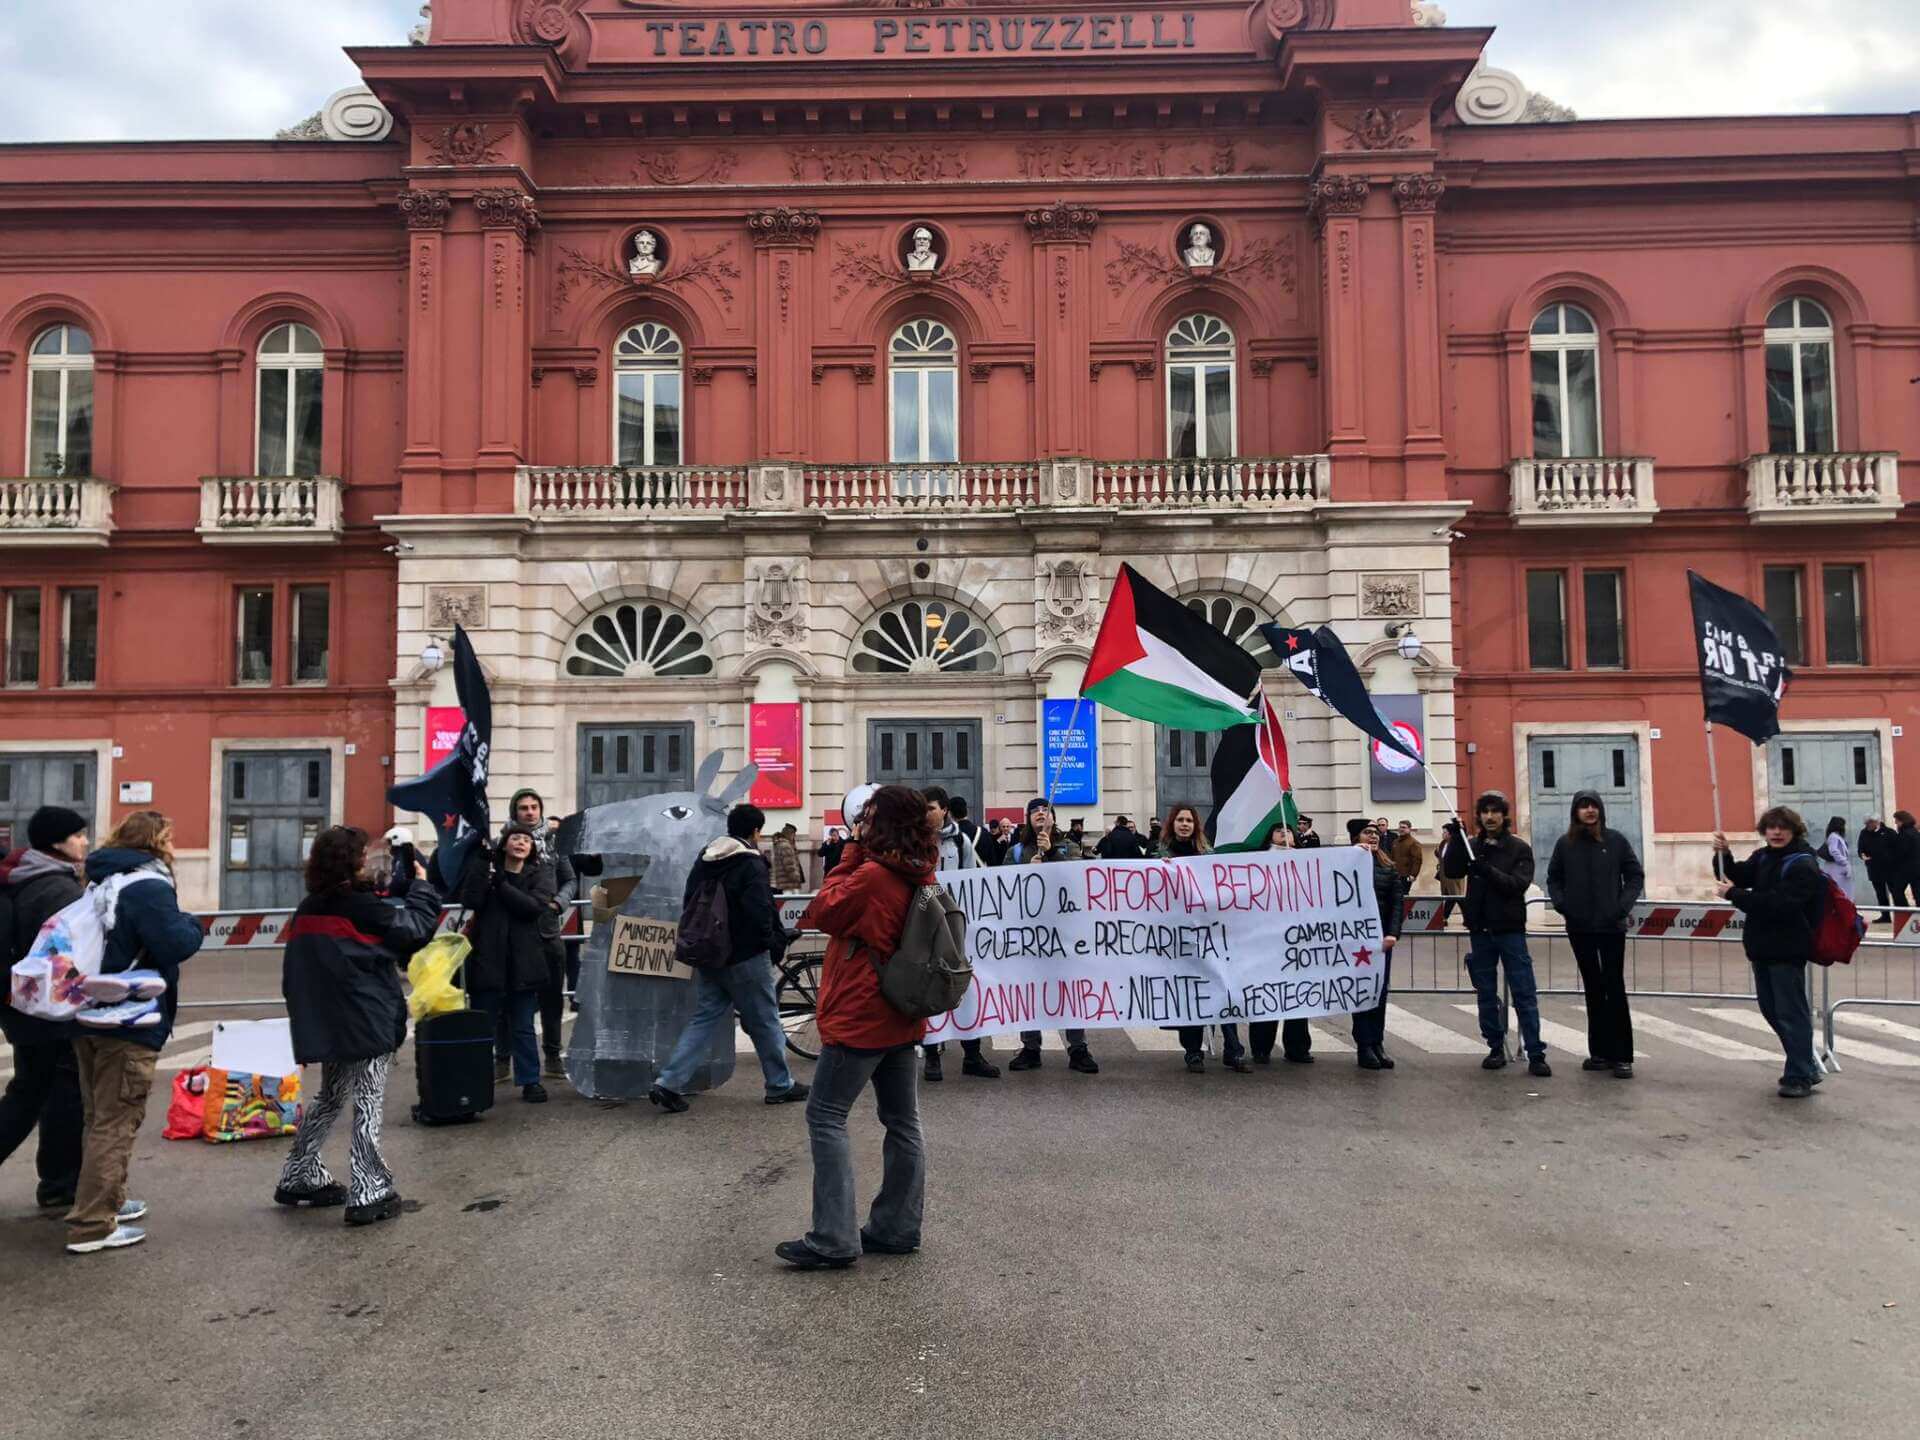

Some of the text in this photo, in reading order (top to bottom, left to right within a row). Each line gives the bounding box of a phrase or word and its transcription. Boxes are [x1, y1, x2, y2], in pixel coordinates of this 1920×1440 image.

[646, 14, 1196, 56] TEATRO PETRUZZELLI
[1057, 886, 1082, 914] la
[1086, 864, 1207, 914] RIFORMA
[1212, 858, 1323, 912] BERNINI
[1333, 869, 1362, 908] DI
[1284, 918, 1379, 945] CAMBIARE
[1407, 910, 1431, 920] BARI
[619, 921, 676, 944] MINISTRA
[975, 924, 1067, 960] GUERRA
[1074, 939, 1090, 955] e
[615, 942, 675, 972] BERNIN
[1128, 975, 1213, 1021] NIENTE
[1219, 989, 1244, 1019] da
[1242, 973, 1380, 1017] FESTEGGIARE!
